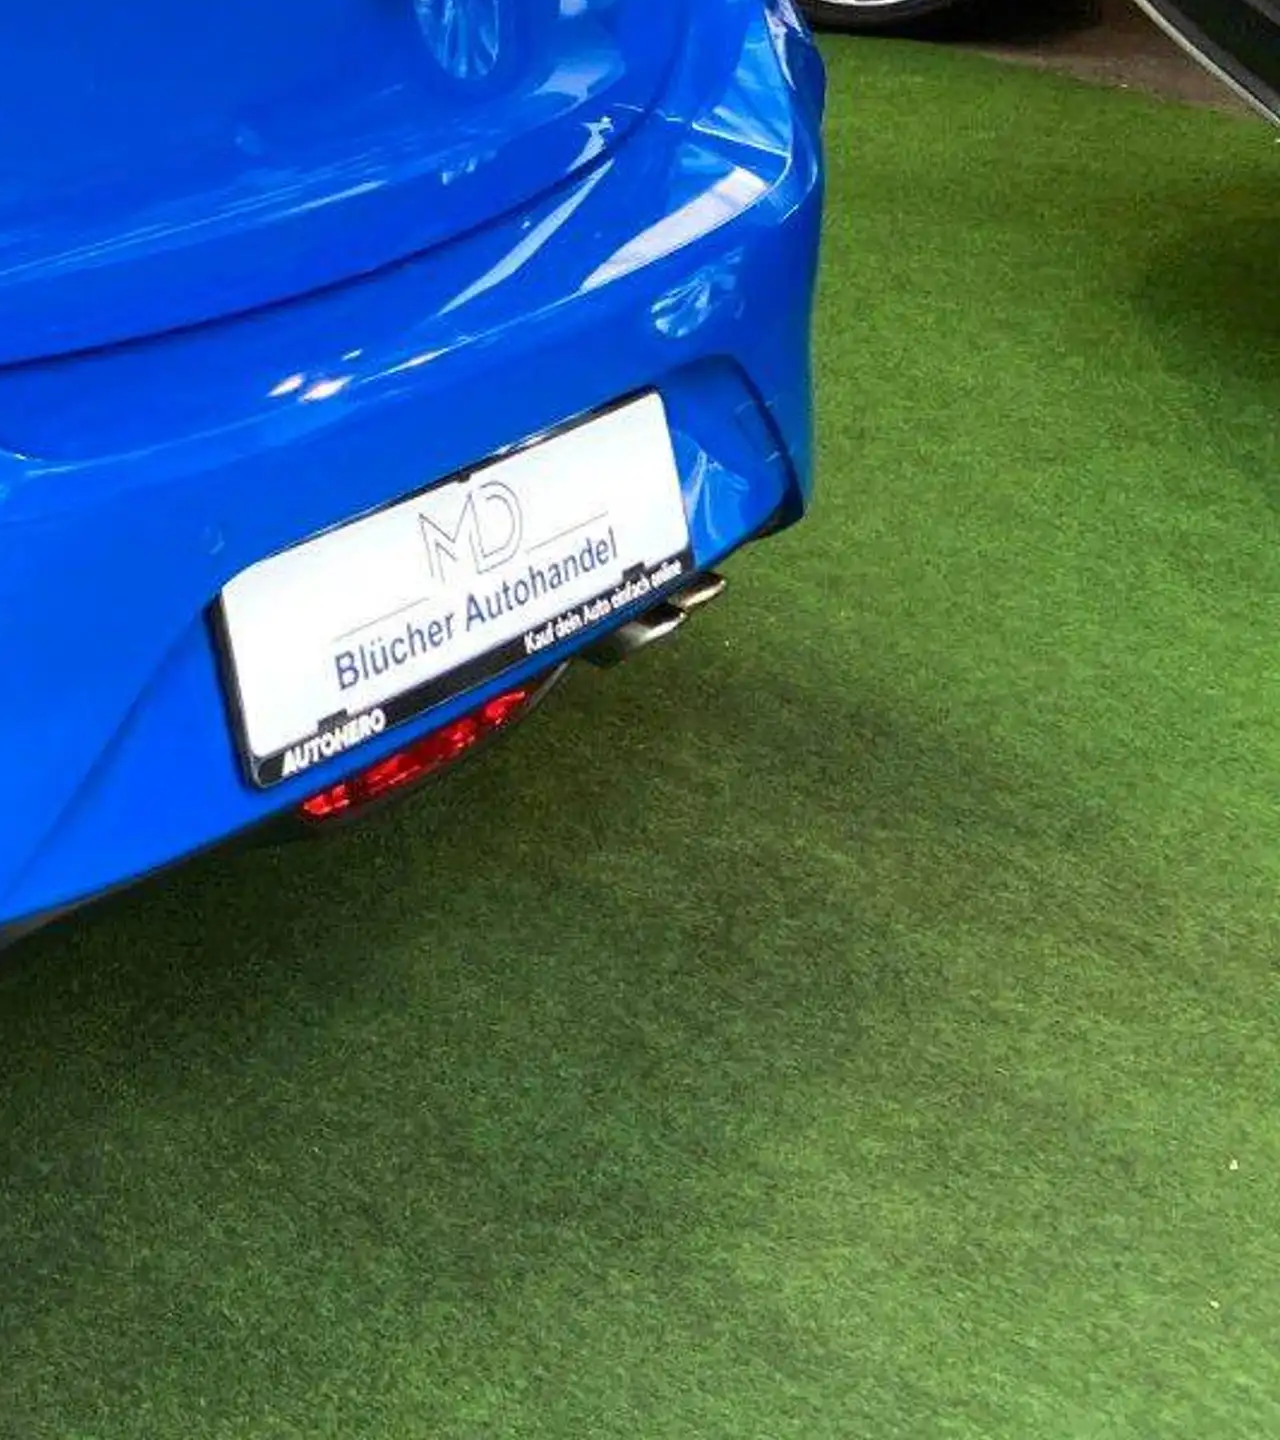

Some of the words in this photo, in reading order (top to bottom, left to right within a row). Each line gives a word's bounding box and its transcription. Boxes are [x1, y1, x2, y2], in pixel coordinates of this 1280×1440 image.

[418, 480, 523, 584] MD
[334, 613, 457, 692] Blücher
[465, 526, 618, 635] Autohandel
[281, 707, 387, 778] AUTOHERO
